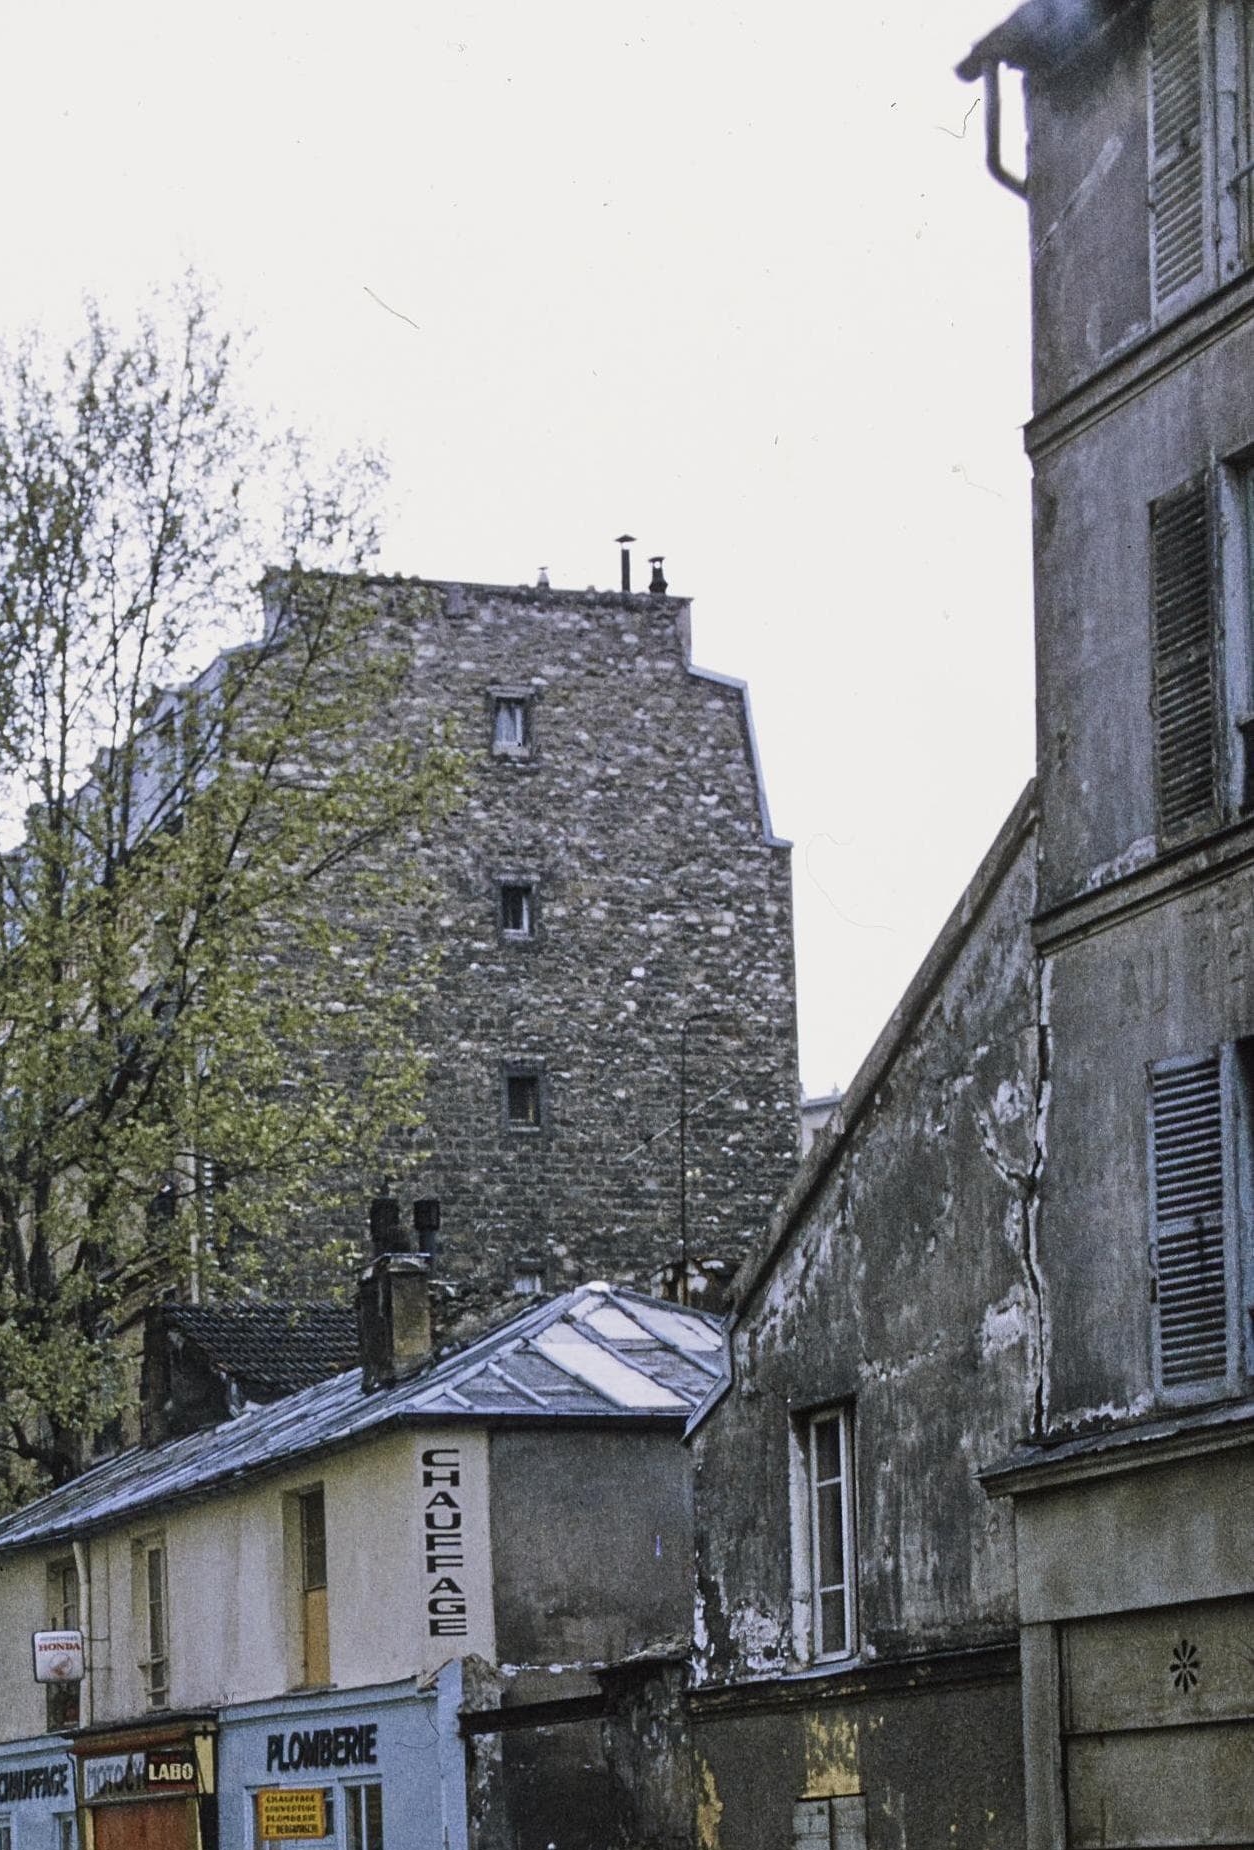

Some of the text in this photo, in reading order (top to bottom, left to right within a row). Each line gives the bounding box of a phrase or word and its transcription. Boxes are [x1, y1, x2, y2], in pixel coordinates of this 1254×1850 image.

[421, 1449, 468, 1636] CHAUFFAGE
[38, 1642, 81, 1652] HONDA
[267, 1723, 377, 1772] PLOMBERIE
[148, 1762, 194, 1780] LABO
